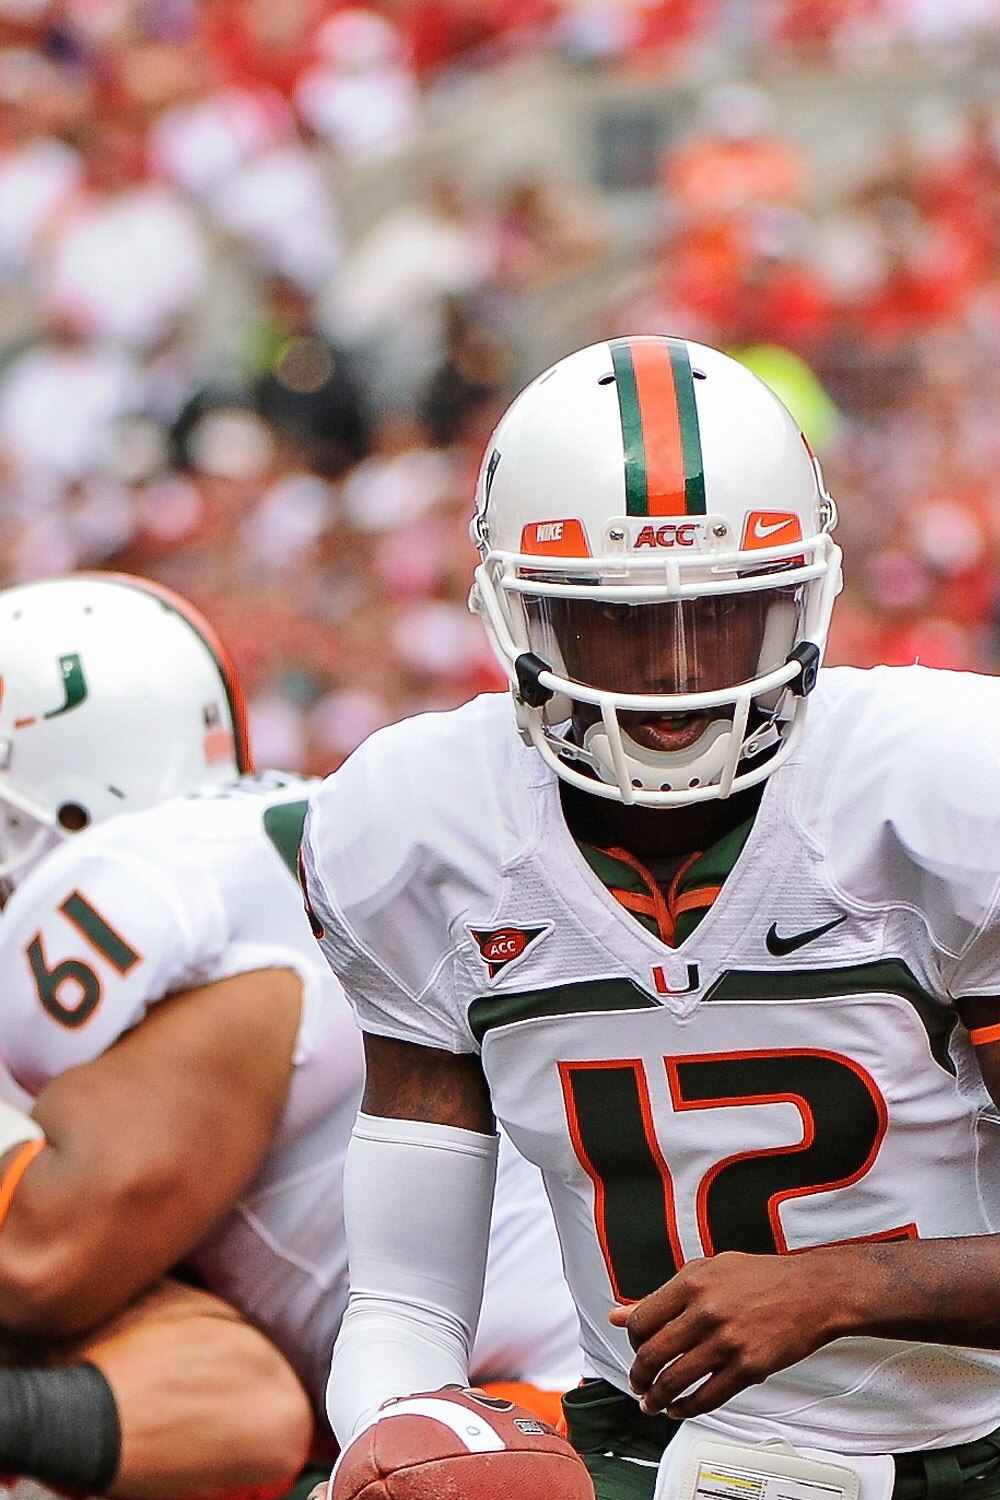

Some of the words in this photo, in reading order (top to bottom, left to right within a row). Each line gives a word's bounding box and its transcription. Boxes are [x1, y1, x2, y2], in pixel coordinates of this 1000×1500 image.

[536, 522, 564, 543] NIKE
[633, 523, 696, 549] ACC
[24, 888, 144, 1031] 61
[489, 938, 517, 956] ACC
[649, 960, 701, 997] U
[556, 1046, 921, 1306] 12
